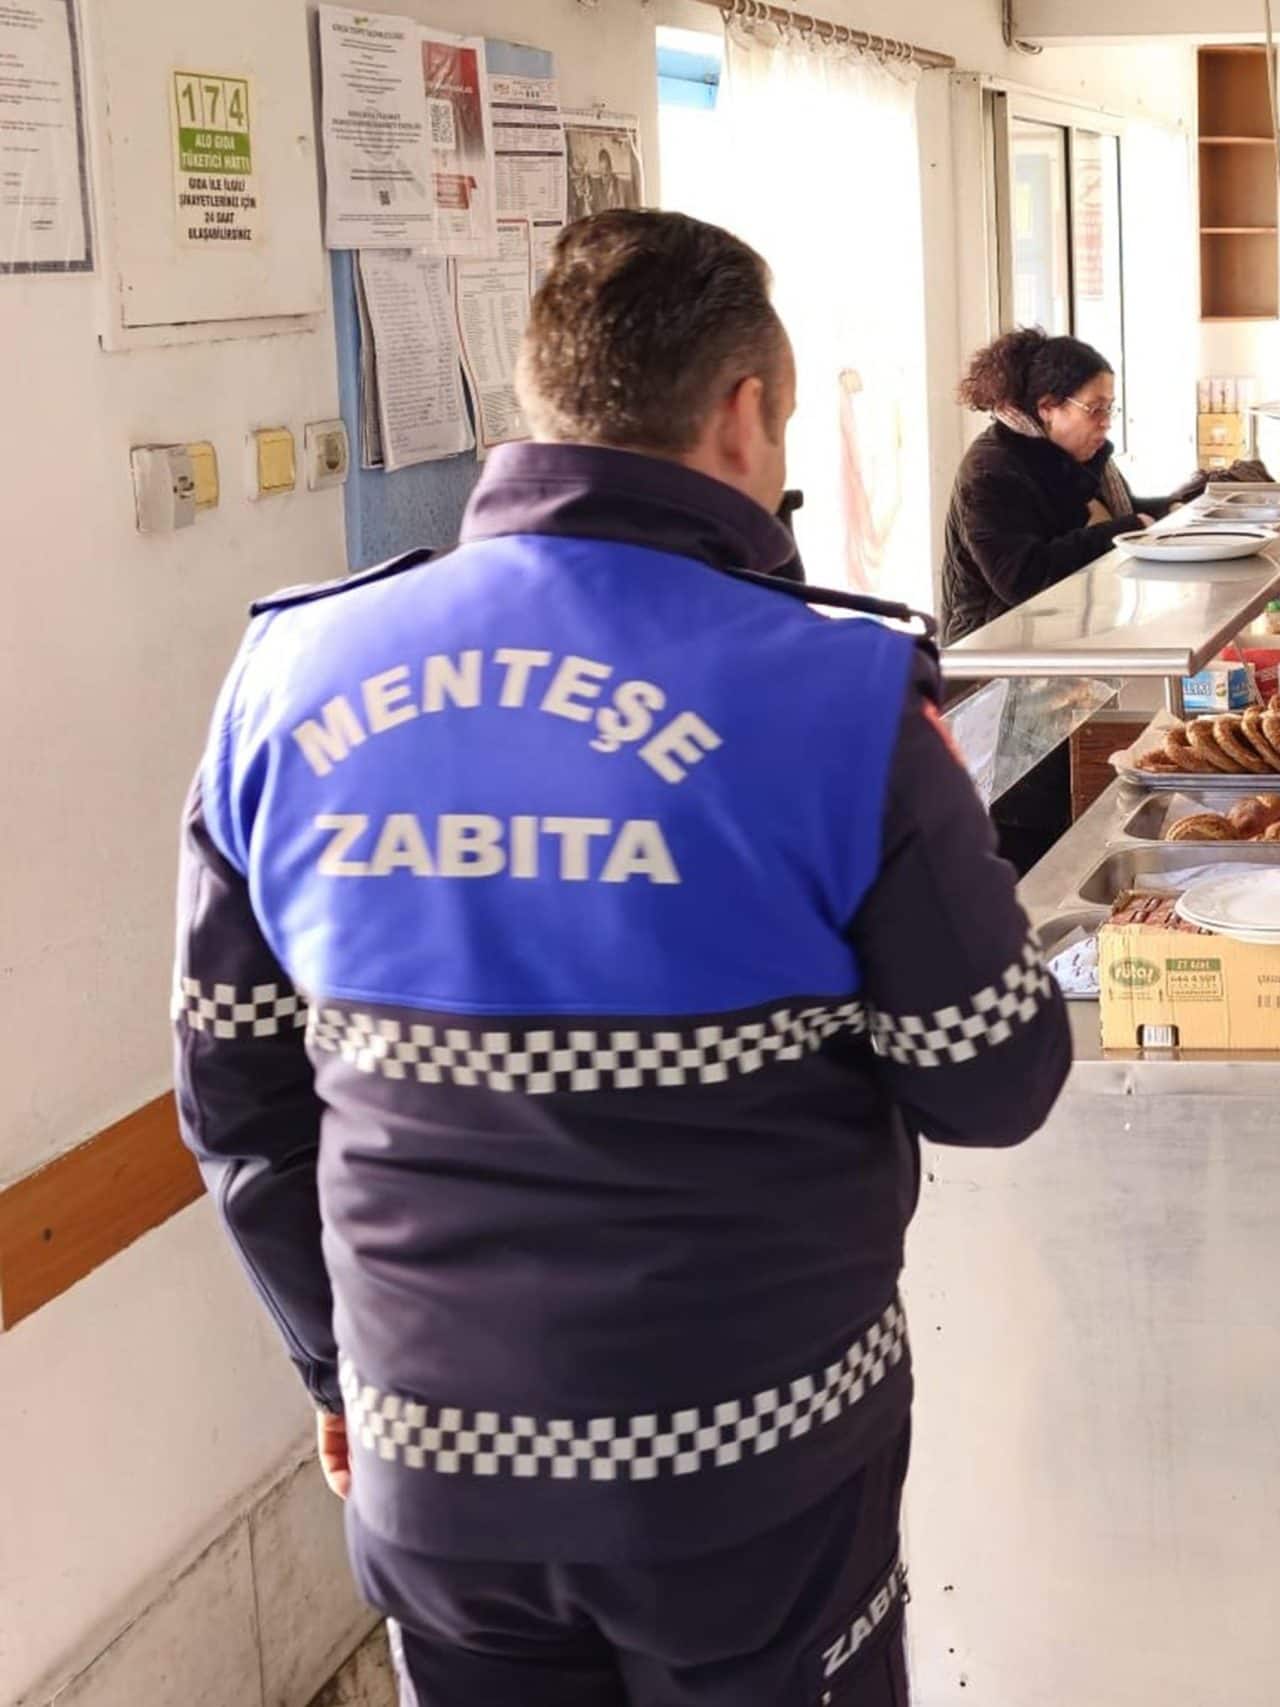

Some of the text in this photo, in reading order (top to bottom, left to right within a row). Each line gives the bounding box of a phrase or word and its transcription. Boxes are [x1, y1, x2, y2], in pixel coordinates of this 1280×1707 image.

[182, 83, 243, 126] 174
[292, 647, 723, 785] MENTEŞE
[314, 813, 682, 885] ZABITA
